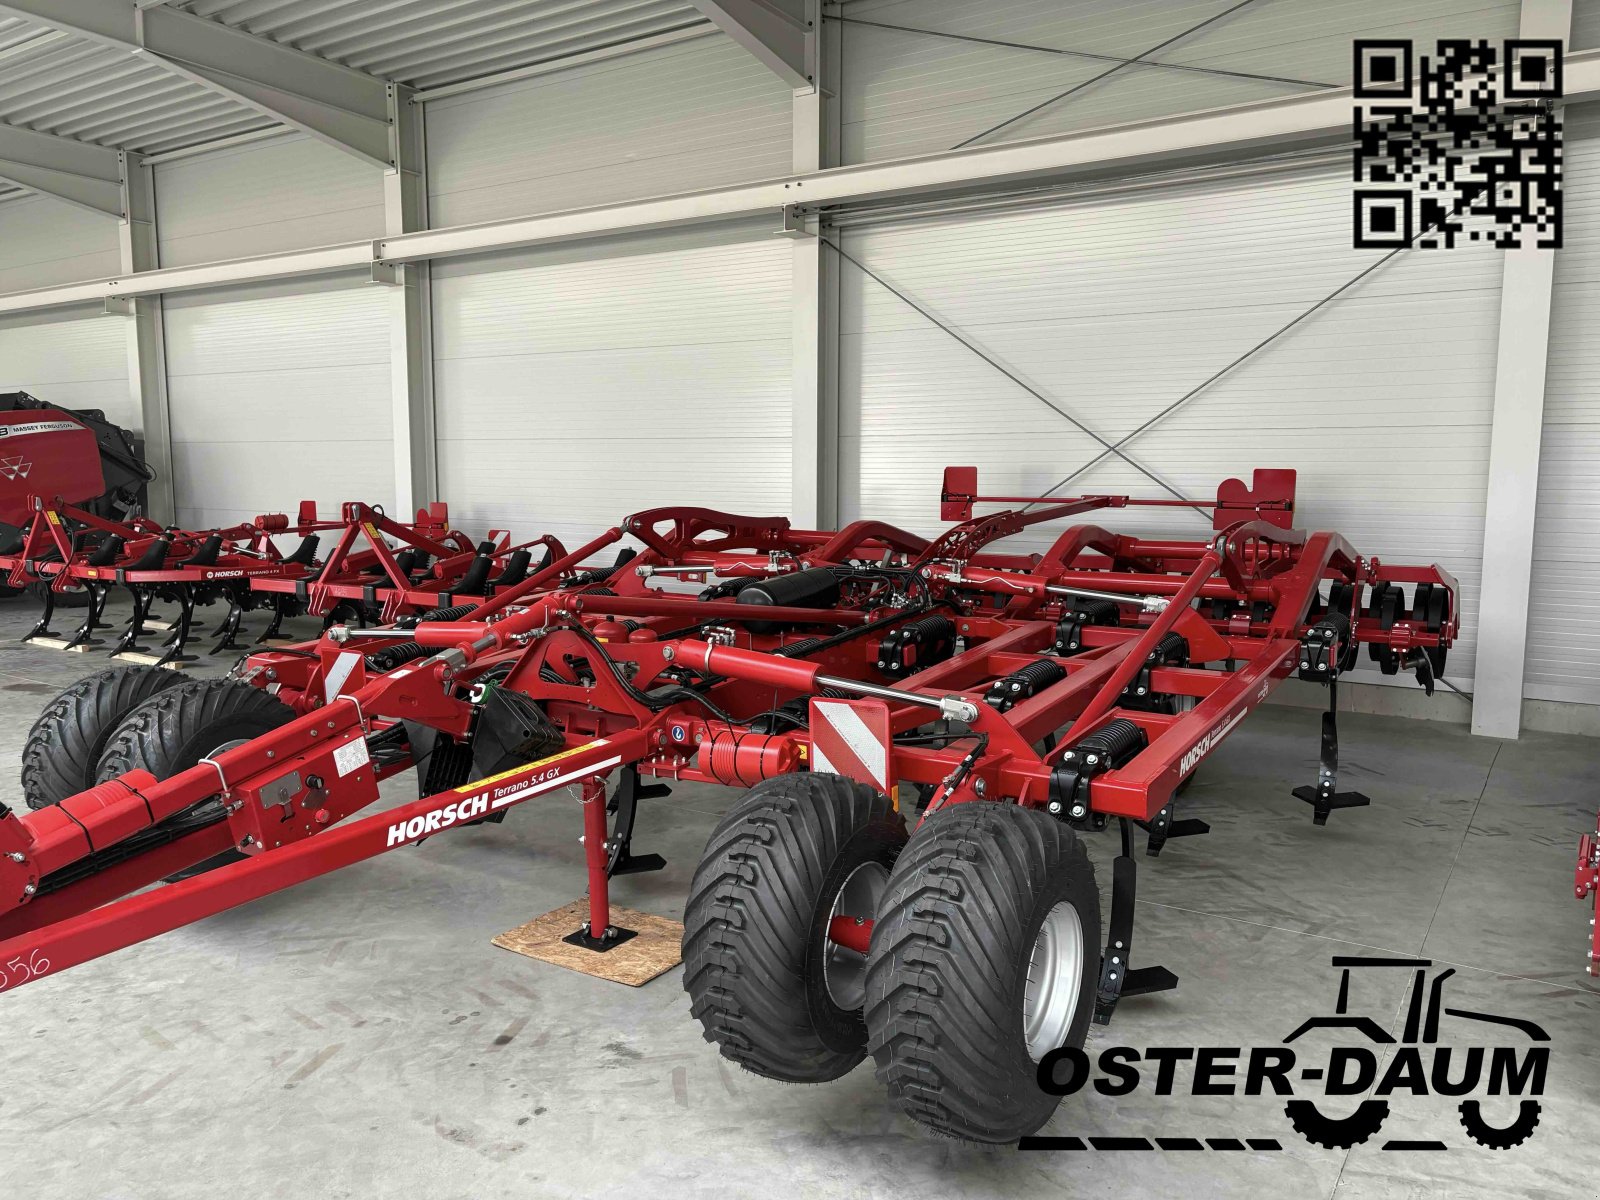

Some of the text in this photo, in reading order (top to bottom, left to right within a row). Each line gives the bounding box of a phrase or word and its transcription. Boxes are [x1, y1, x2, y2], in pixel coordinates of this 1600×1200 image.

[214, 570, 244, 578] HORSCH
[1180, 733, 1211, 777] HORSCH
[387, 767, 561, 847] HORSCH Terrano 5.4 GX
